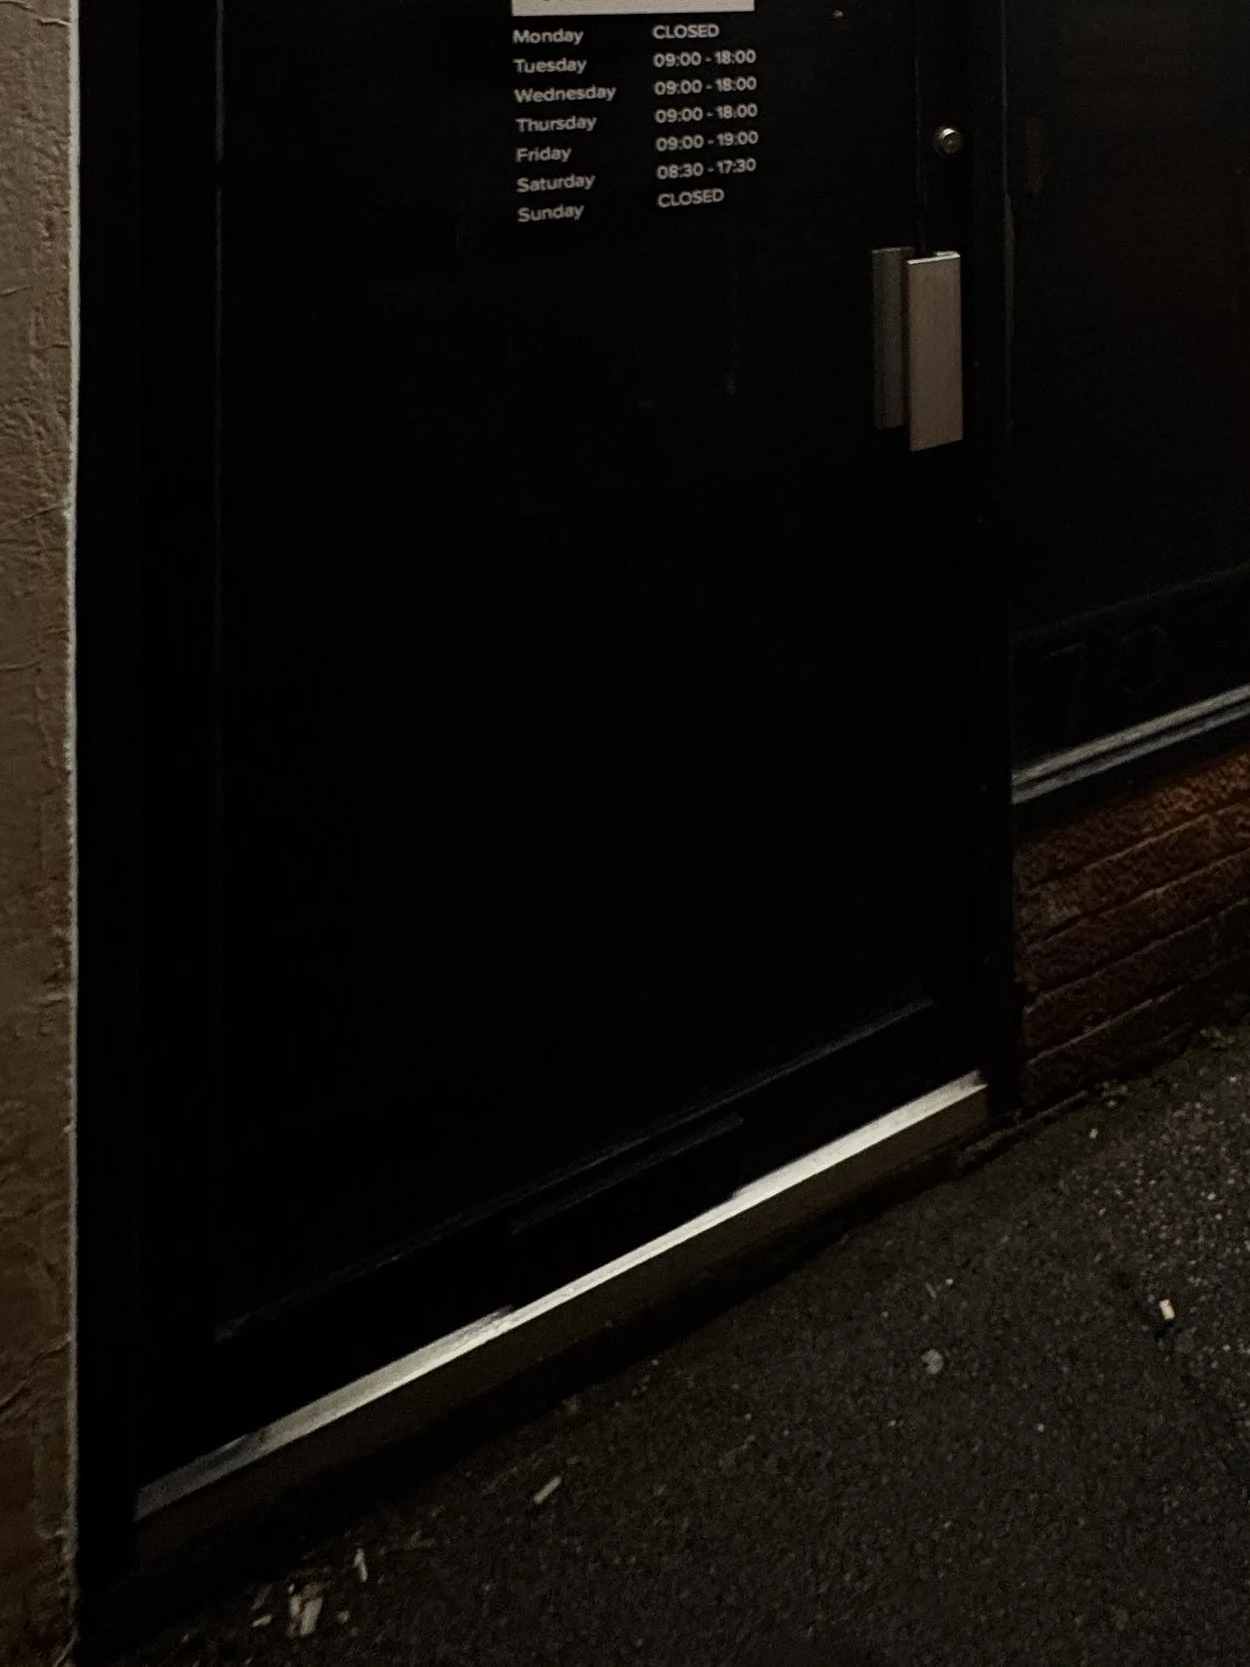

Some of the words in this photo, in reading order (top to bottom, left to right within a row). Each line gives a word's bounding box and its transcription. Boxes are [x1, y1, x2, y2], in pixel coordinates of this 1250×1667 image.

[512, 27, 584, 45] Monday
[652, 23, 720, 39] CLOSED
[513, 58, 587, 74] Tuesday
[653, 51, 702, 68] 09:00
[713, 48, 757, 64] 18:00
[513, 85, 618, 103] Wednesday
[653, 79, 702, 96] 09:00
[714, 76, 757, 92] 18:00
[515, 115, 598, 133] Thursday
[654, 106, 703, 123] 09:00
[715, 103, 758, 119] 18:00
[515, 146, 572, 163] Friday
[655, 134, 704, 152] 09:00
[716, 130, 759, 147] 19:00
[516, 174, 596, 193] Saturday
[656, 162, 704, 180] 08:30
[715, 157, 757, 175] 17:30
[517, 204, 585, 222] Sunday
[656, 188, 725, 208] CLOSED
